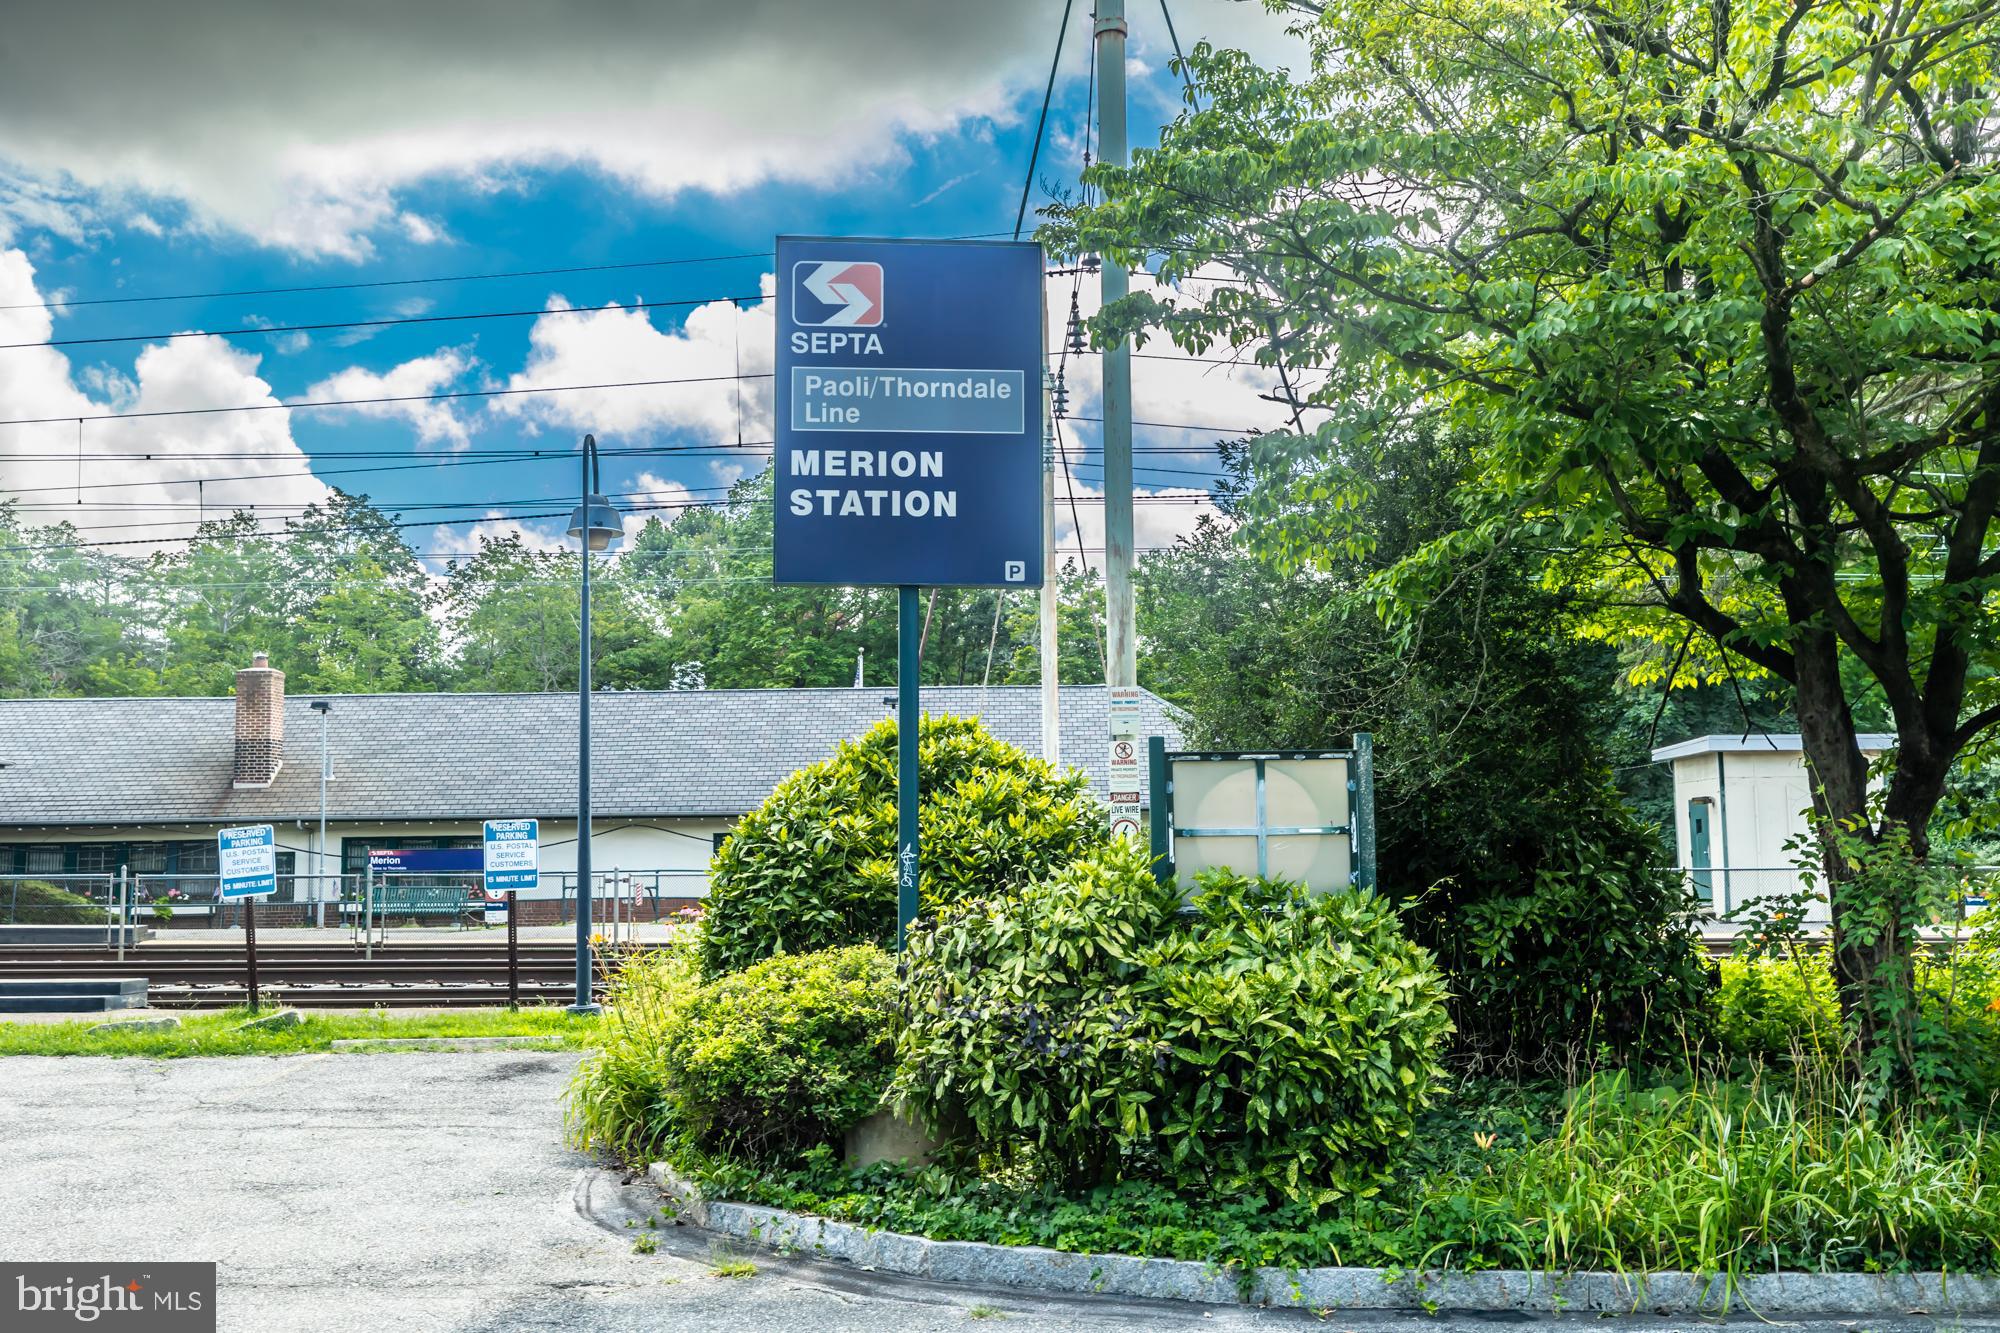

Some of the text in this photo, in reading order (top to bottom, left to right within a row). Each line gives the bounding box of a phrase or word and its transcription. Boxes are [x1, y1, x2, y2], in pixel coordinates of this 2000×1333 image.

[790, 332, 884, 355] SEPTA
[804, 375, 1012, 400] Paoli/Thorndale
[804, 402, 861, 424] Line
[790, 449, 944, 478] MERION
[790, 489, 957, 517] STATION
[1009, 565, 1021, 579] P
[1111, 805, 1139, 813] LIVE WIRE
[496, 831, 528, 840] PARKING
[231, 837, 264, 848] PARKING
[225, 847, 269, 858] U.S. POSTAL
[496, 851, 525, 859] SERVICE
[231, 856, 262, 866] SERVICE
[370, 856, 401, 864] Merion
[490, 860, 533, 868] CUSTOMERS
[225, 864, 270, 875] CUSTOMERS
[232, 880, 256, 889] MINUTE
[257, 878, 273, 887] LIMIT
